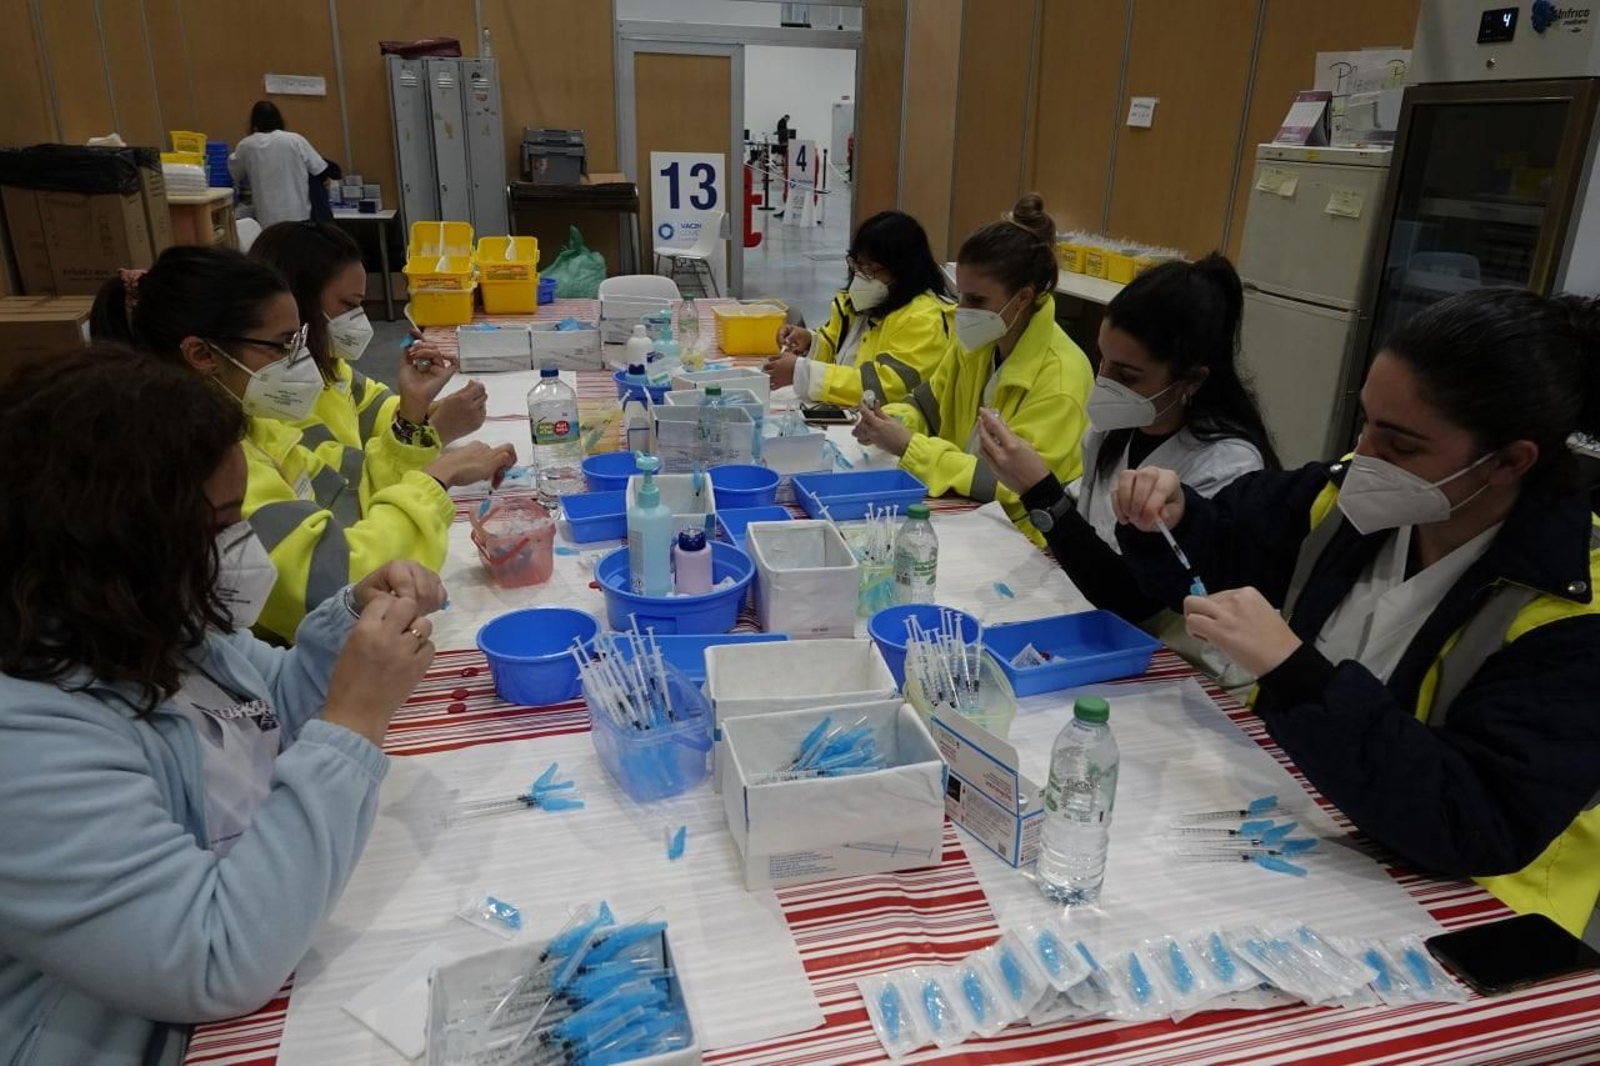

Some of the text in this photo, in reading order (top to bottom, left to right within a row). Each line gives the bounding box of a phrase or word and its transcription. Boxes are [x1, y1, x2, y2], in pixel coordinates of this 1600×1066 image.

[1502, 12, 1512, 28] 4
[796, 144, 807, 172] 4
[660, 162, 717, 210] 13
